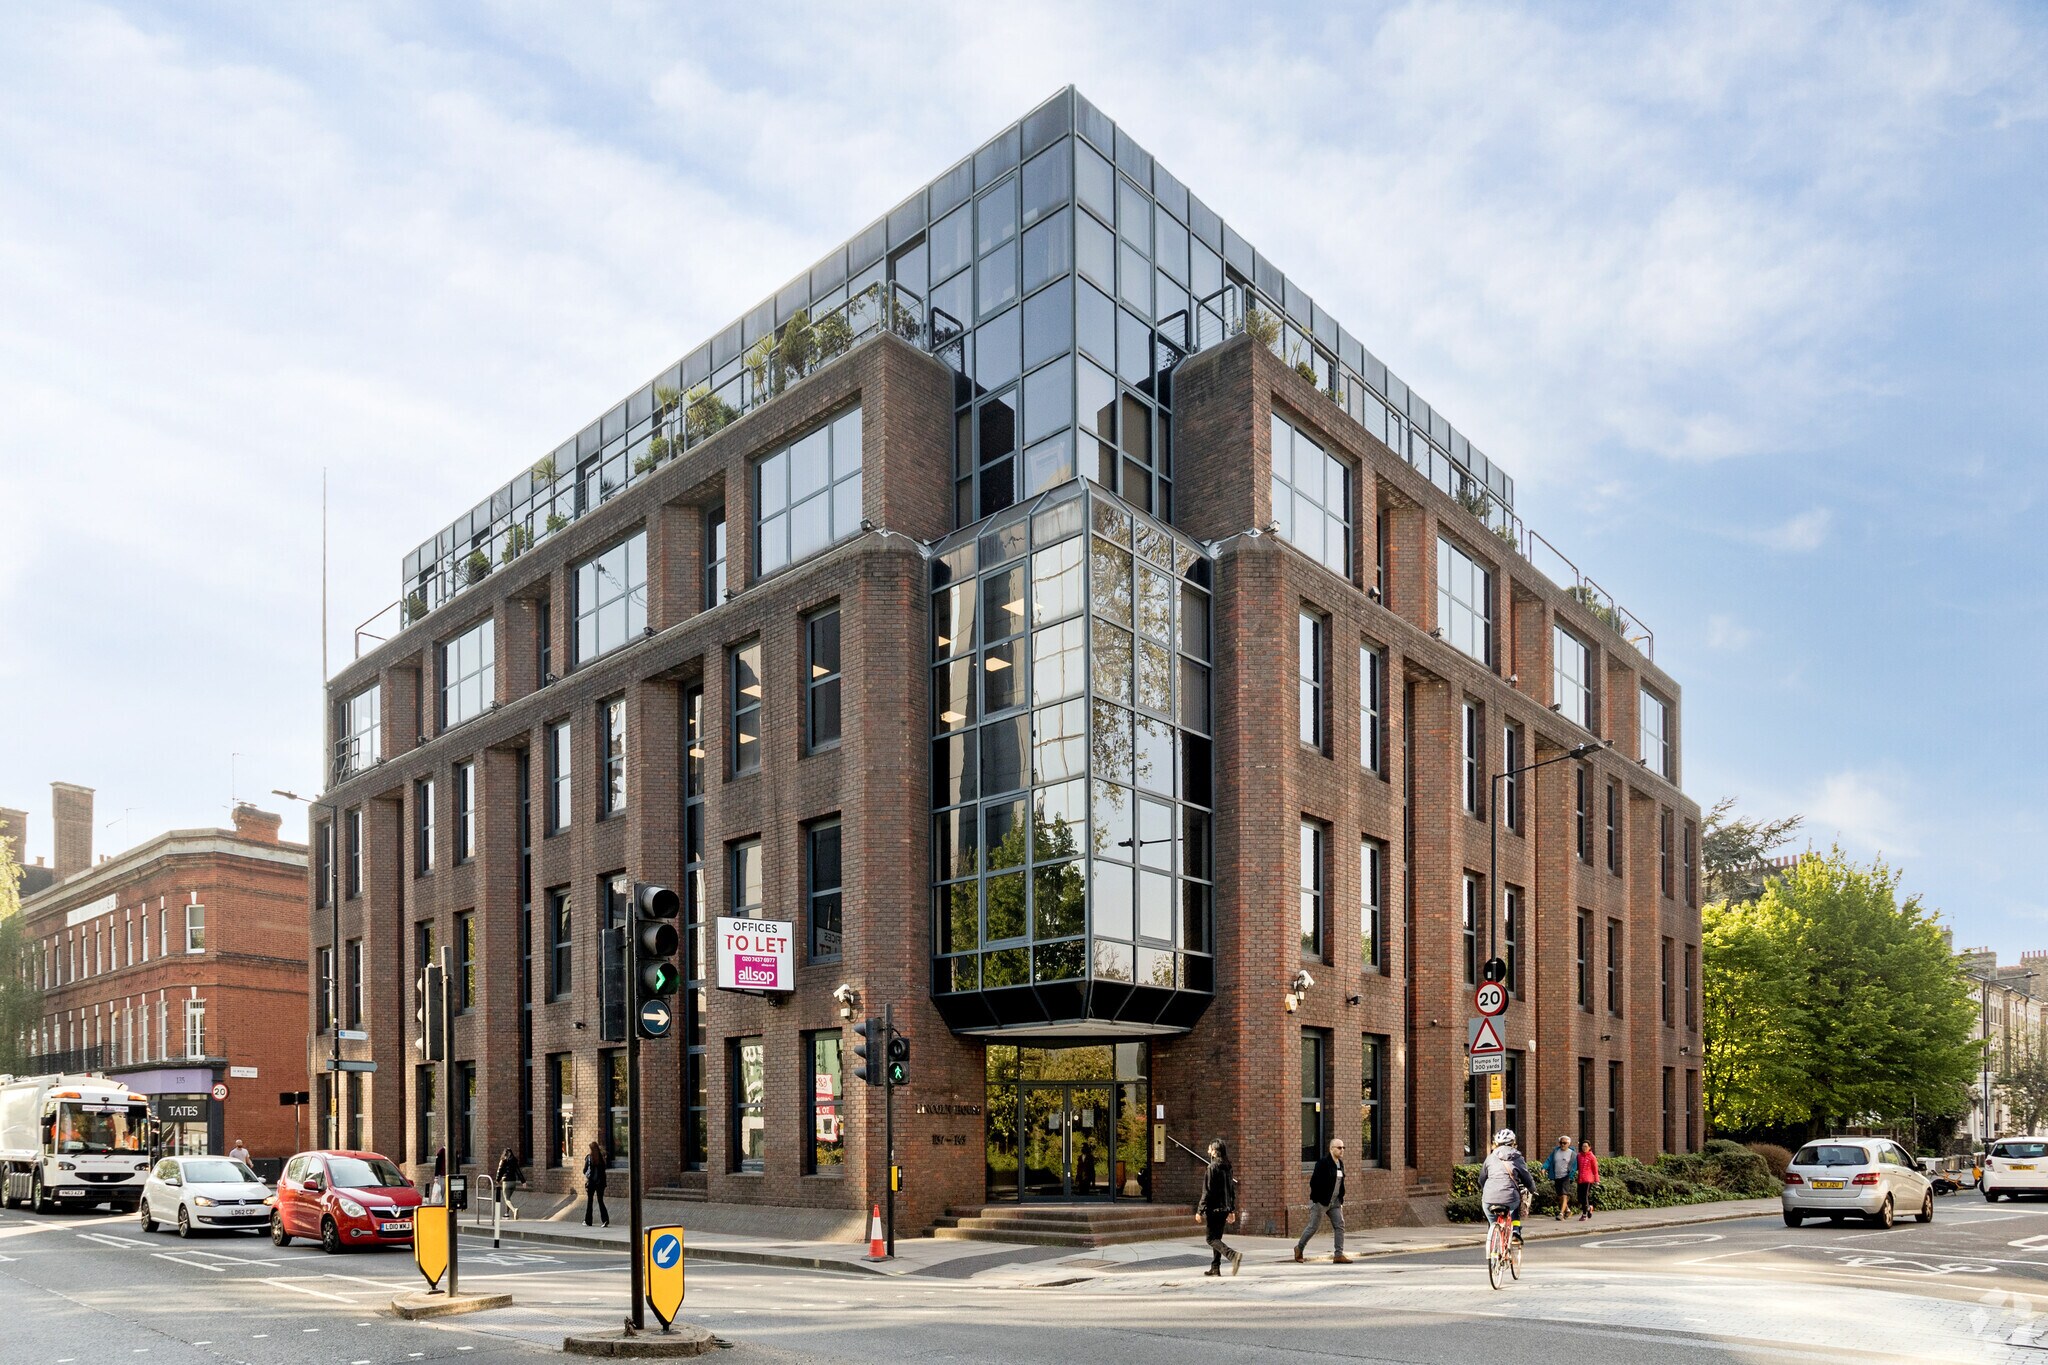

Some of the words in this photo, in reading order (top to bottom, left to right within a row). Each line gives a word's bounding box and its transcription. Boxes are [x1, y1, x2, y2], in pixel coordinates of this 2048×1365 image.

[733, 921, 778, 934] OFFICES
[724, 934, 749, 951] TO
[755, 936, 787, 953] LET
[738, 966, 775, 984] allsop
[1479, 990, 1501, 1007] 20
[176, 1076, 186, 1084] 135
[214, 1088, 226, 1096] 20
[168, 1105, 198, 1117] TATES
